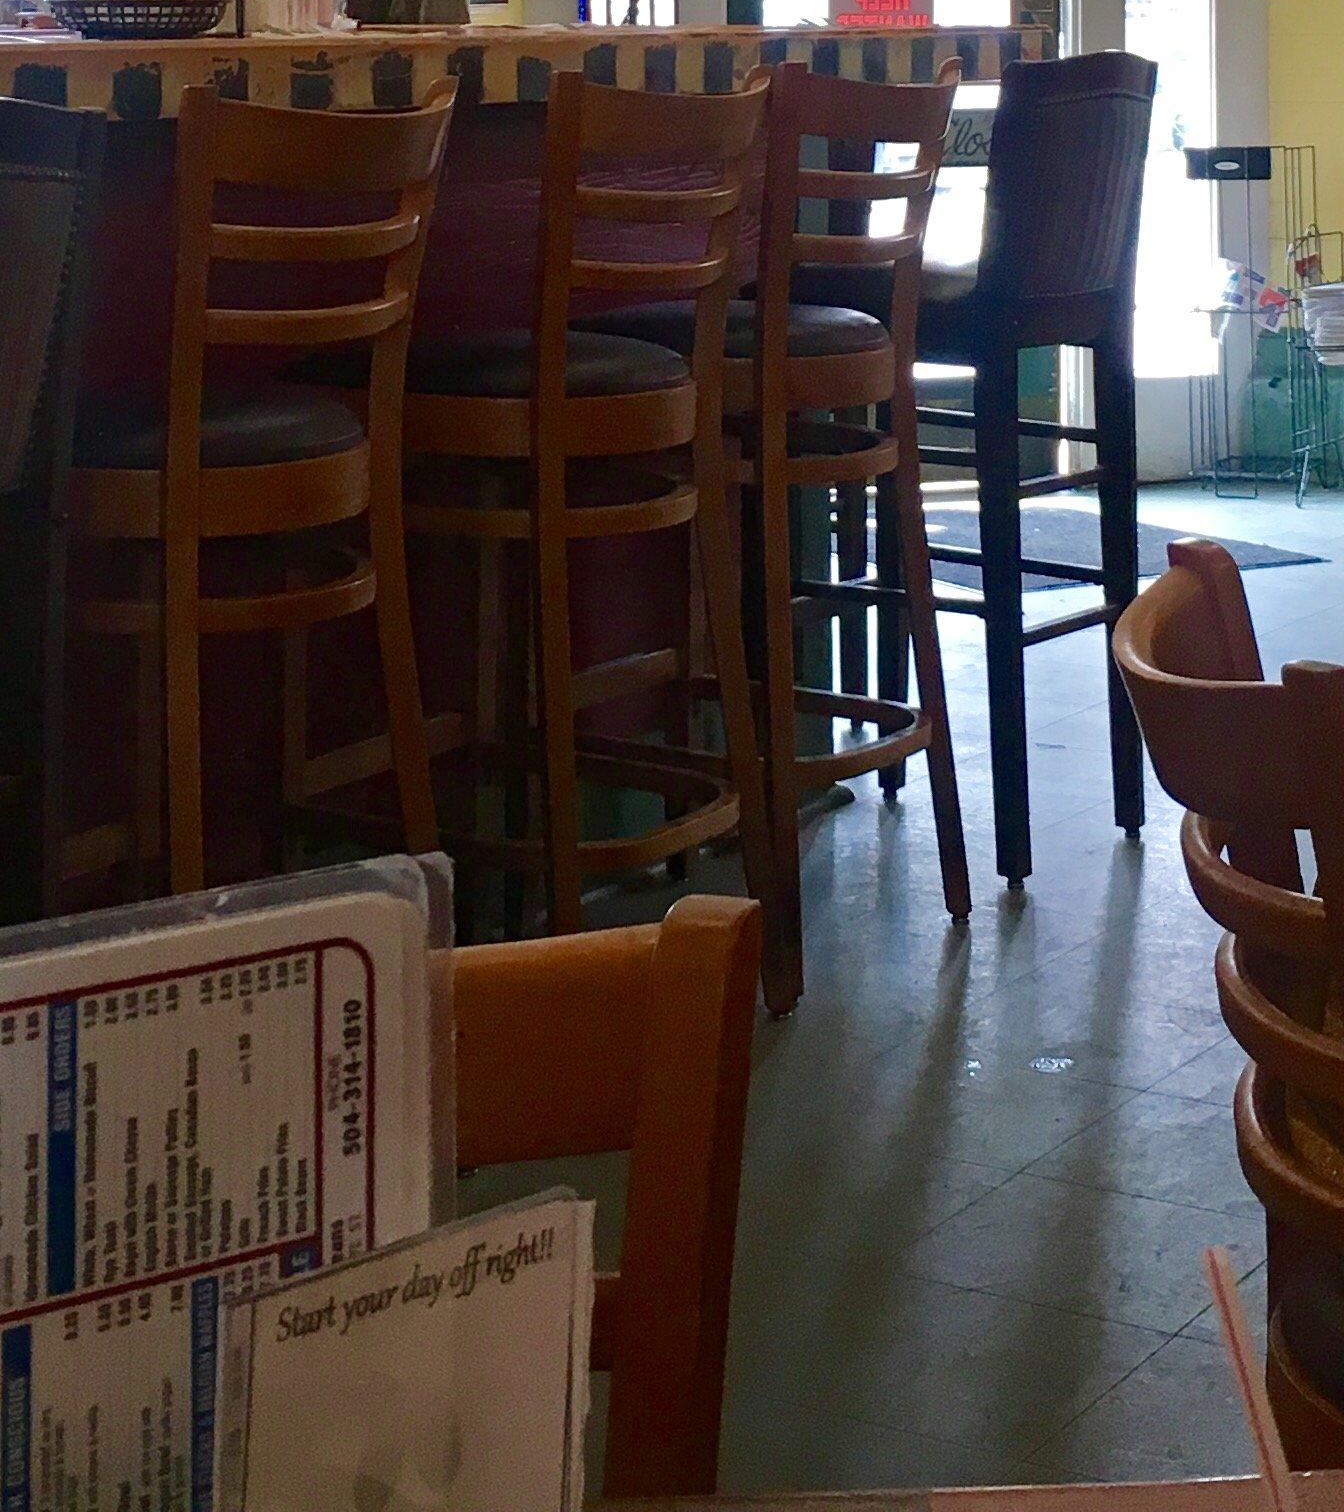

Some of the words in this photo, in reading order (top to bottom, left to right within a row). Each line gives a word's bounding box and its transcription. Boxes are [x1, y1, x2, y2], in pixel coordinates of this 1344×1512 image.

[53, 1004, 72, 1080] ORDERS
[342, 999, 362, 1157] 504-314-1810
[276, 1296, 336, 1342] Start
[339, 1286, 399, 1336] your
[402, 1264, 444, 1308] day
[448, 1242, 486, 1298] off
